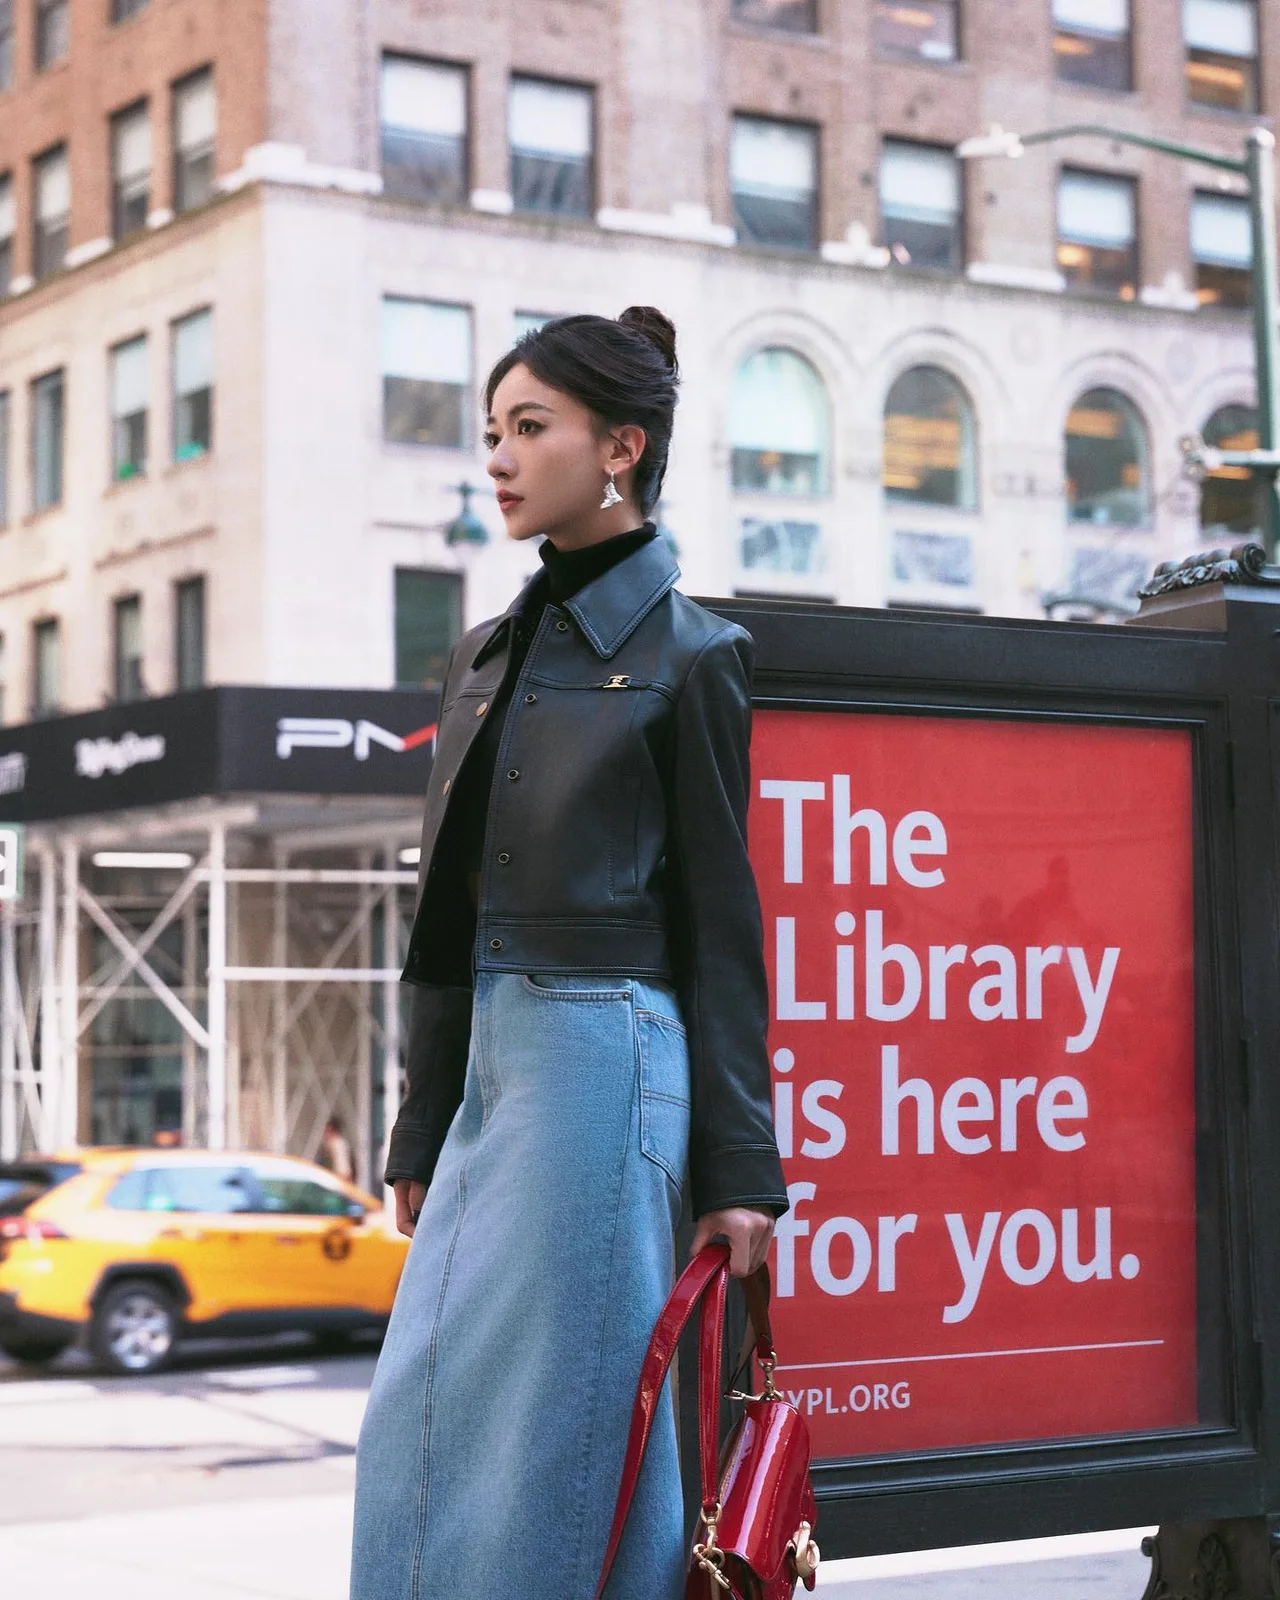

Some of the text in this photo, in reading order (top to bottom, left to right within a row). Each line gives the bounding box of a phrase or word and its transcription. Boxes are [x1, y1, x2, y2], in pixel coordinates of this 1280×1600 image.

[759, 774, 948, 888] The
[775, 909, 1121, 1053] Library
[773, 1044, 1089, 1160] is here
[773, 1181, 1140, 1324] for you.
[780, 1381, 911, 1416] YPL.ORG
